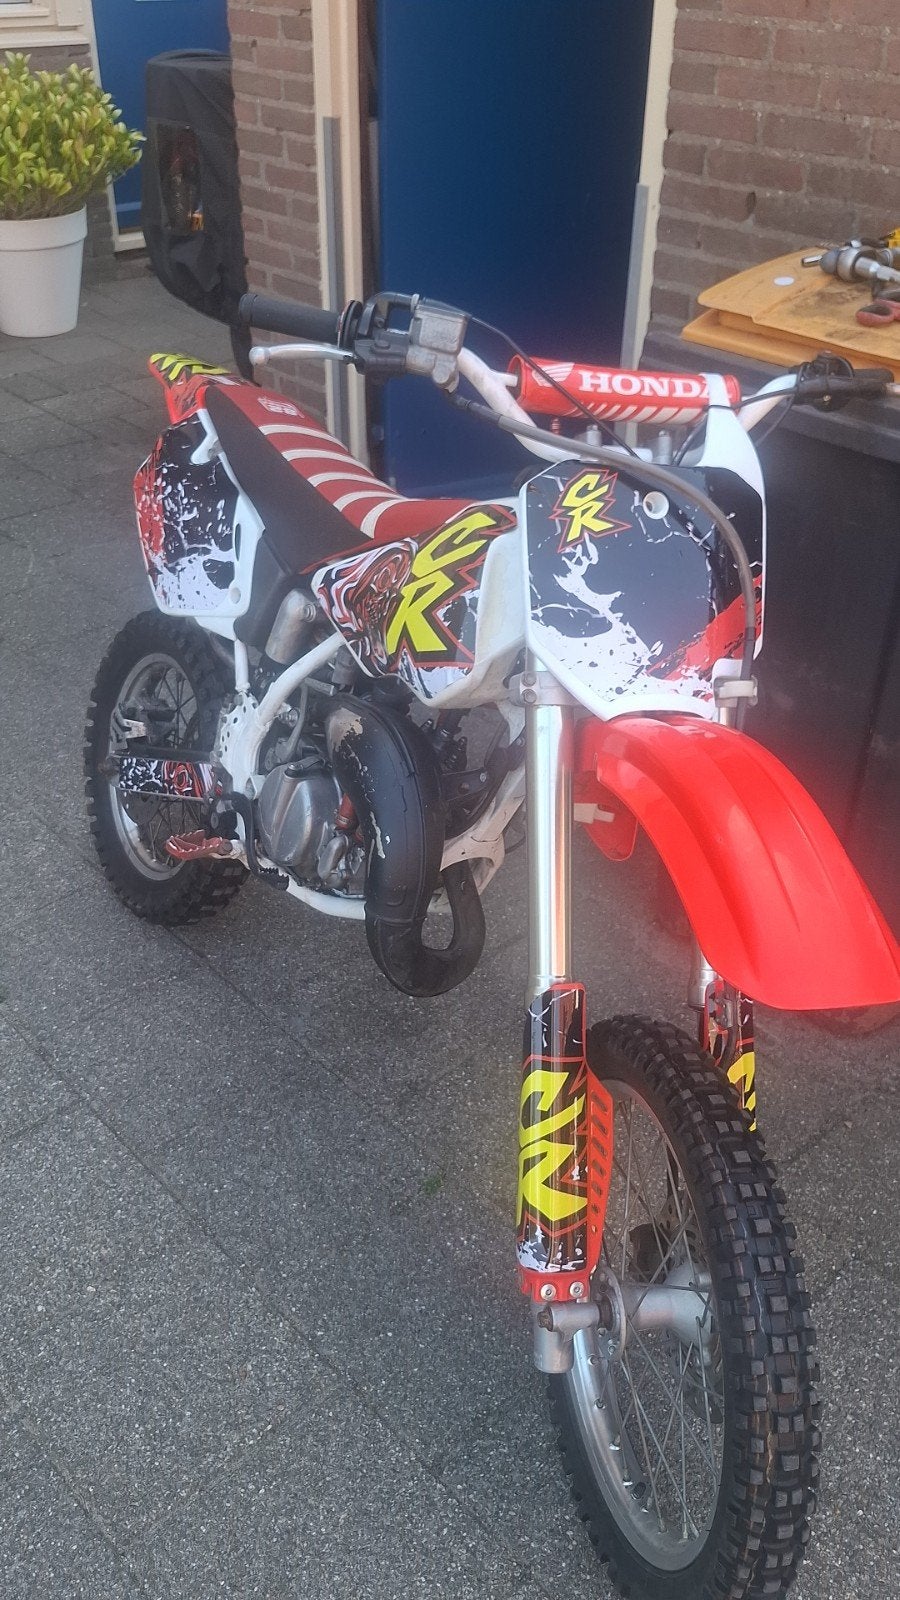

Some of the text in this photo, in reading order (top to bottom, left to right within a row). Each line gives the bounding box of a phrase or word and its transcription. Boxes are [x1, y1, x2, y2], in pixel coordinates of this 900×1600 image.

[562, 474, 615, 542] CR
[386, 511, 497, 655] CR
[515, 1069, 588, 1228] CR
